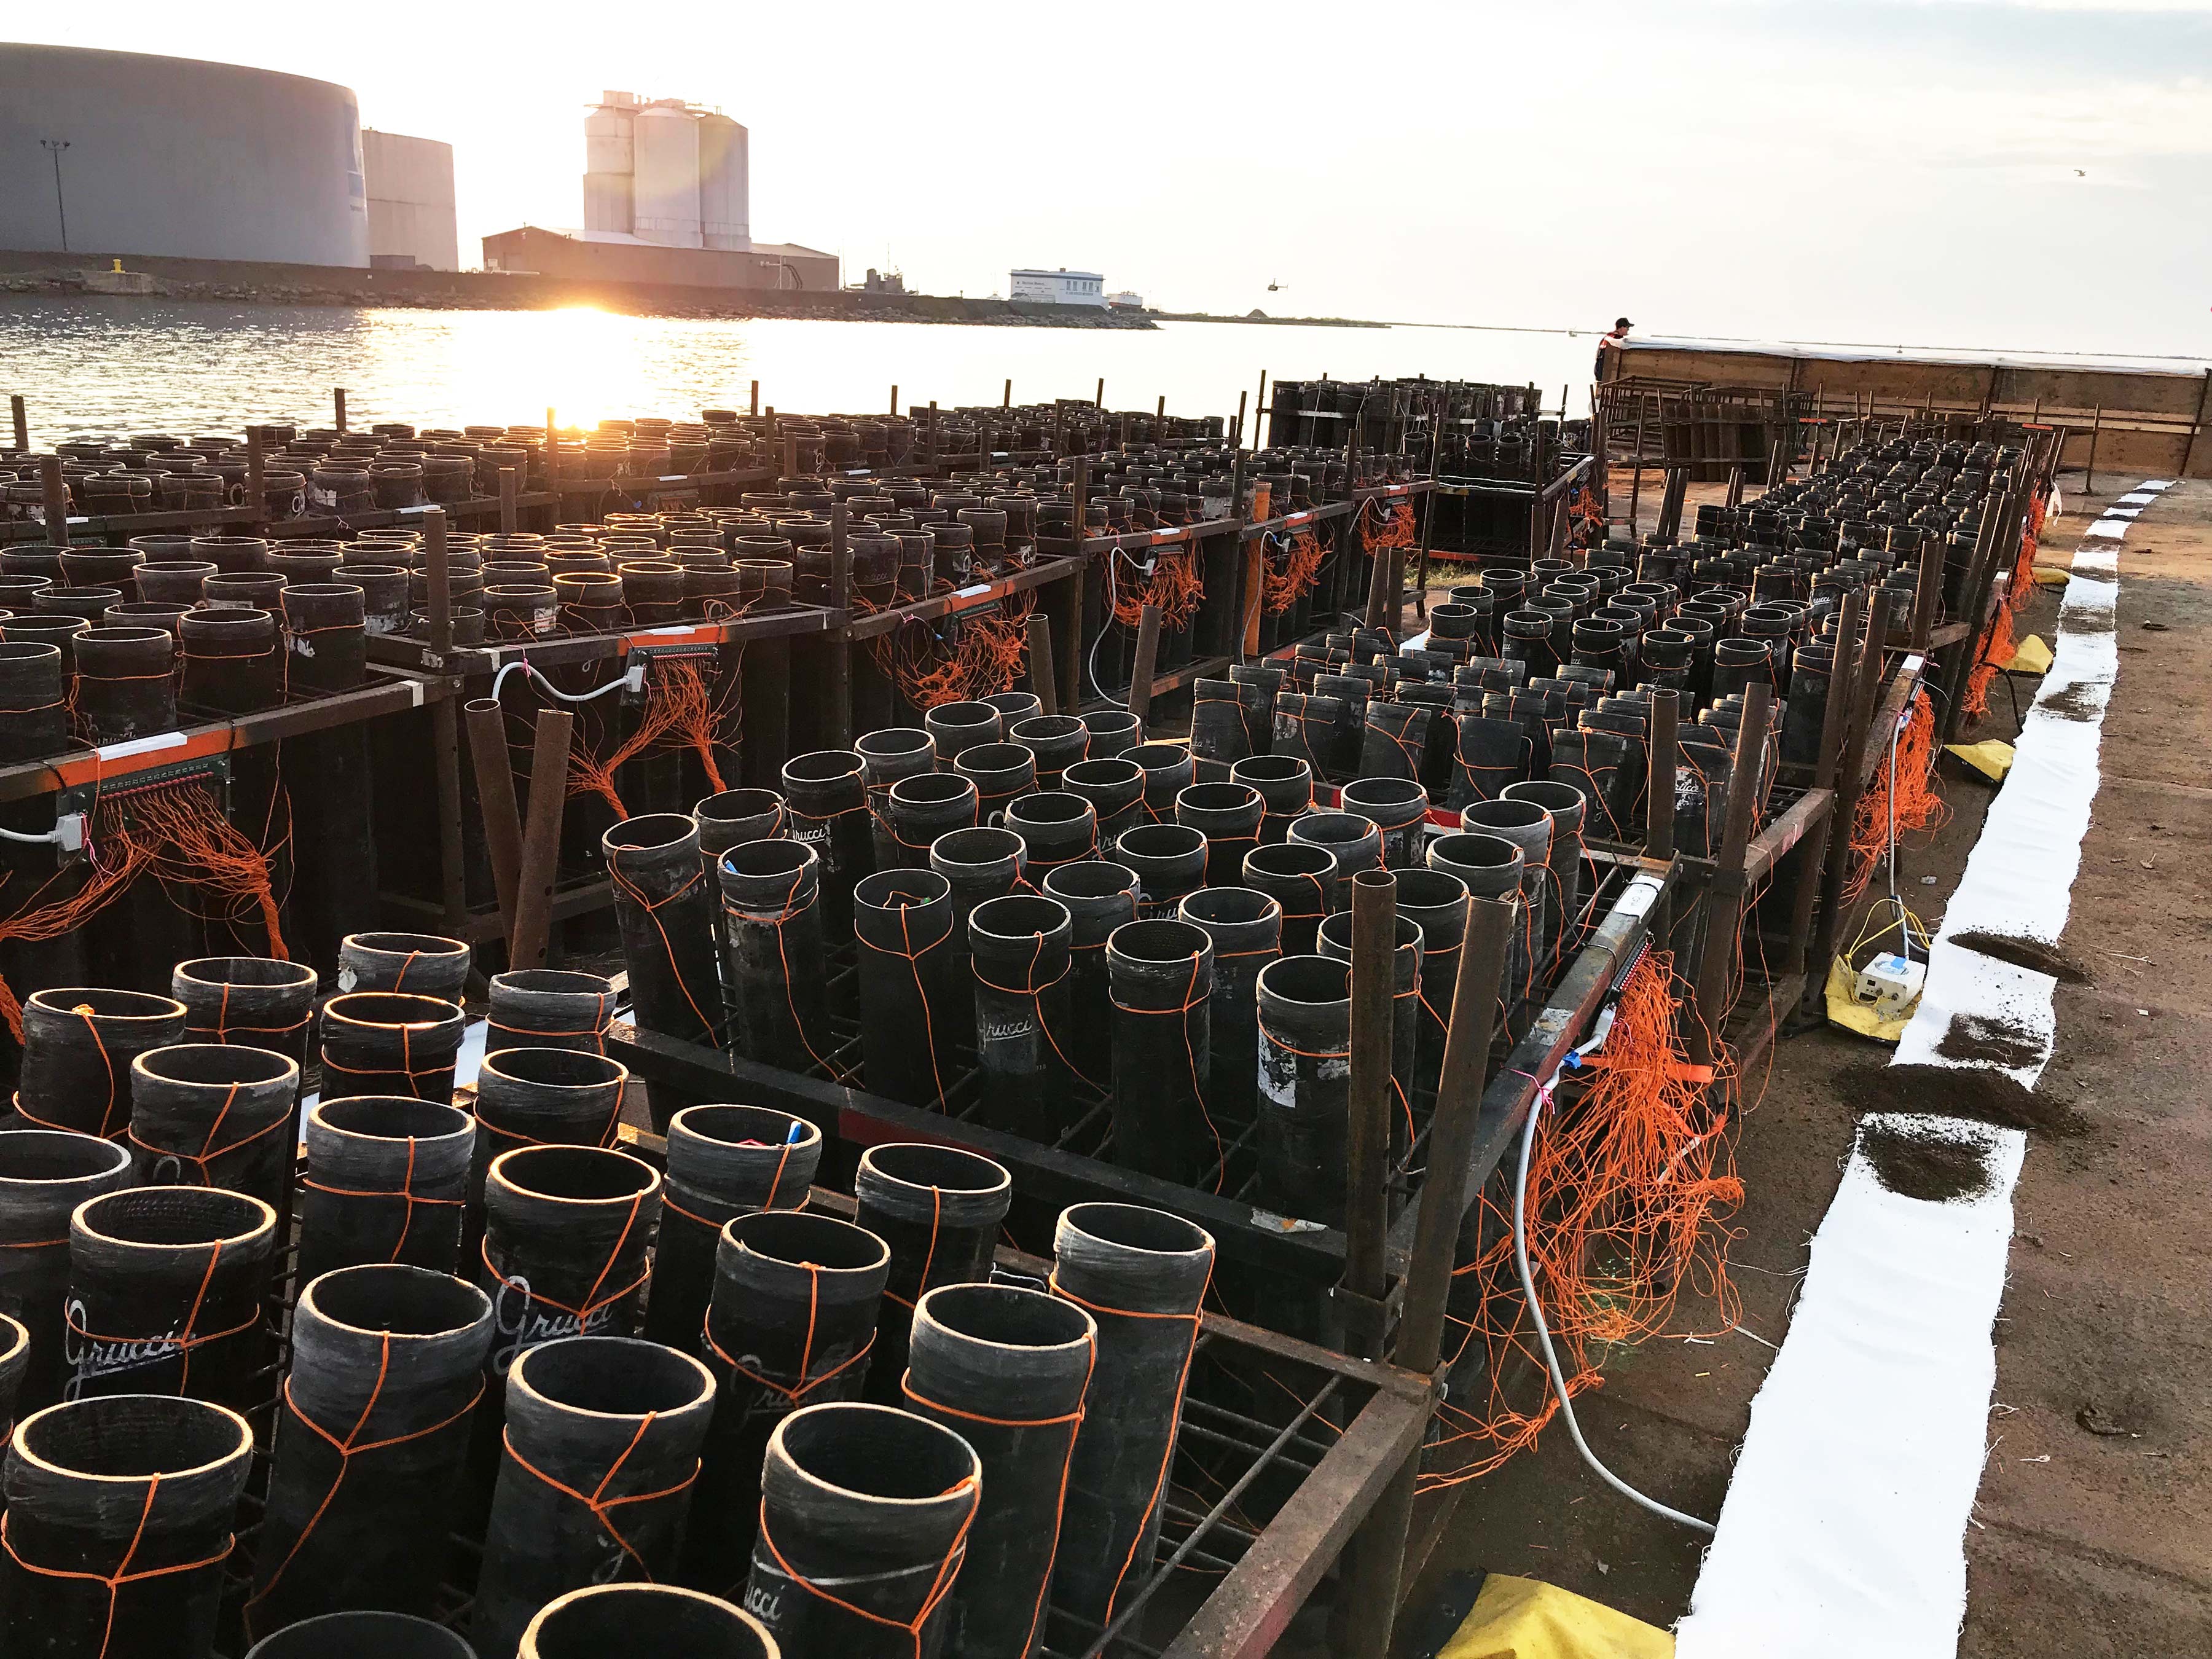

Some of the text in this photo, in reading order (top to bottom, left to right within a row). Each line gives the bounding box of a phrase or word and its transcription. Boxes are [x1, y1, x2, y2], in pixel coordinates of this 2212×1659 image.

[793, 823, 825, 843] rucci
[64, 1300, 179, 1400] Grucci
[745, 1585, 785, 1621] ucci
